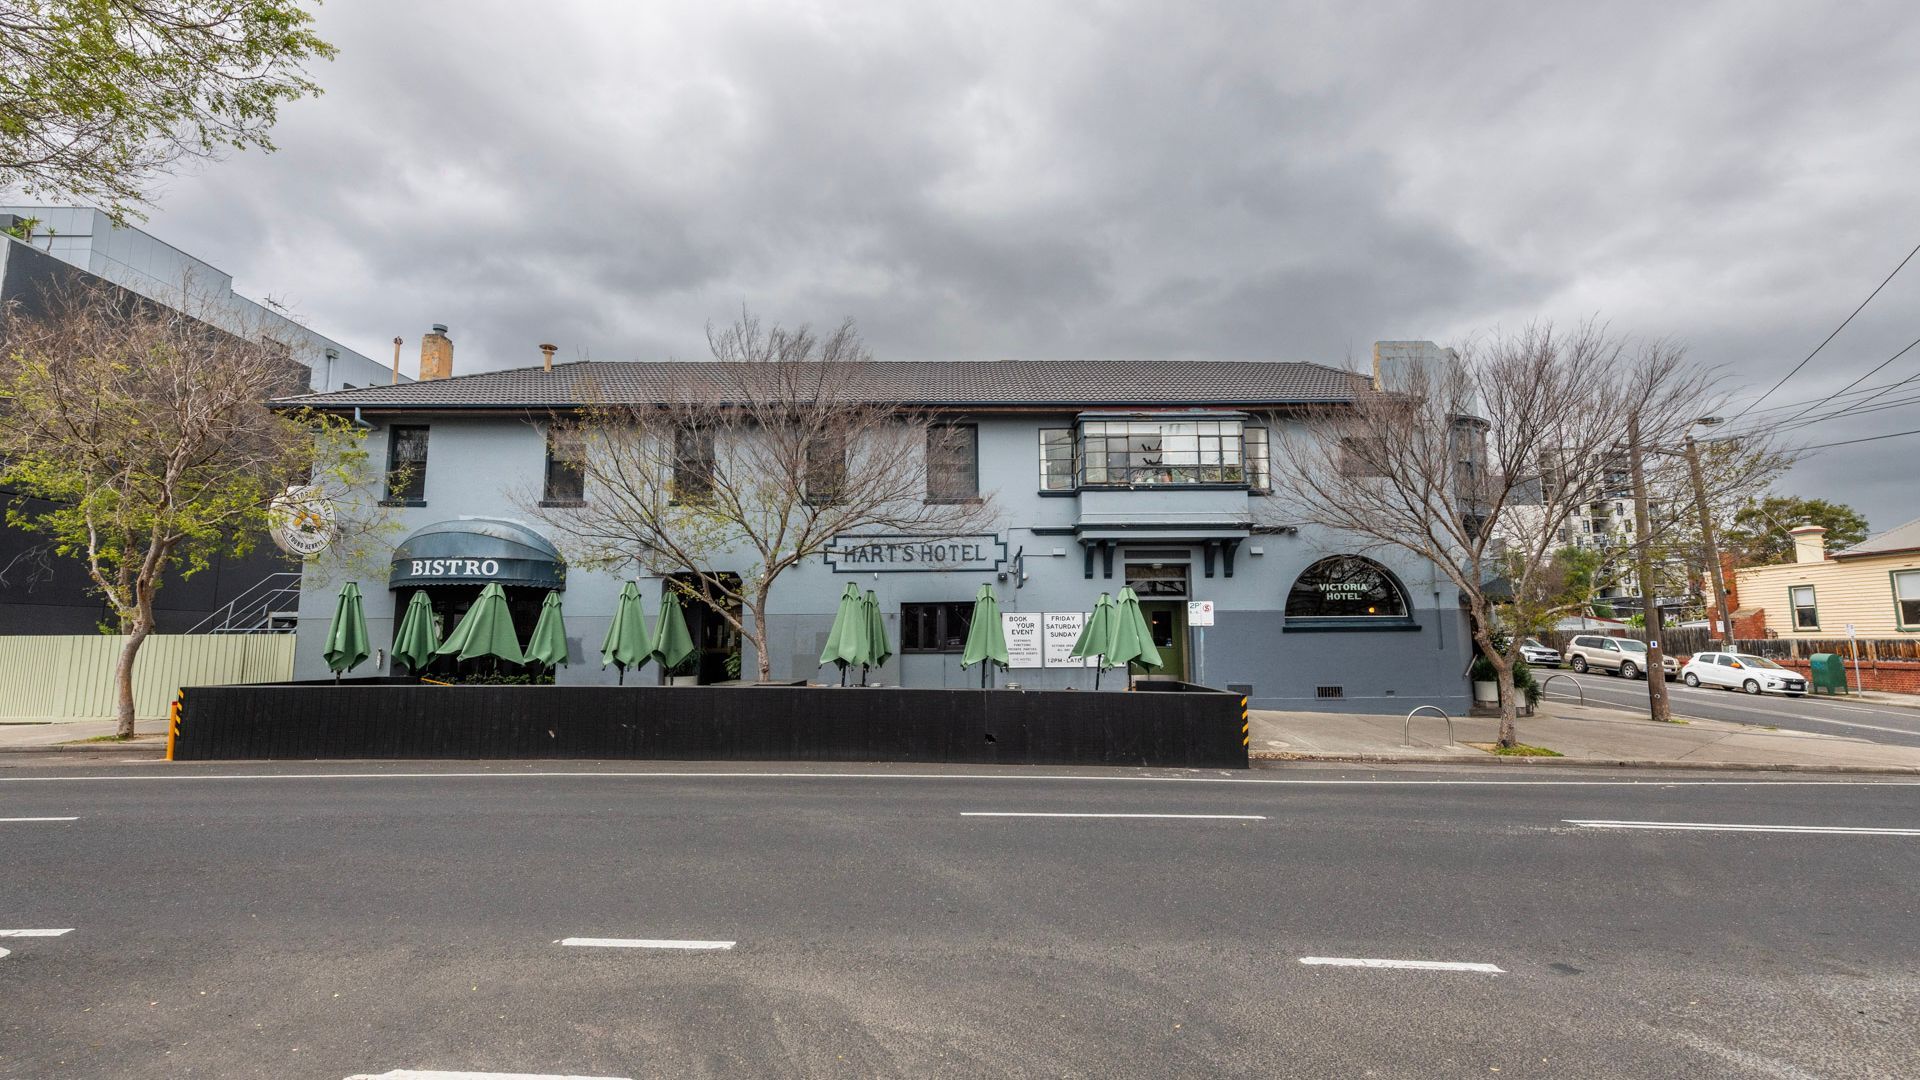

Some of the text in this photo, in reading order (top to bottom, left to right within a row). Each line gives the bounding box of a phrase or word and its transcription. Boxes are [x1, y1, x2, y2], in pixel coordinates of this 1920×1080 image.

[289, 534, 304, 549] YOUNG
[844, 544, 987, 563] HART'S HOTEL
[410, 560, 499, 576] BISTRO
[1319, 583, 1368, 591] VICTORIA
[1326, 592, 1362, 600] HOTEL
